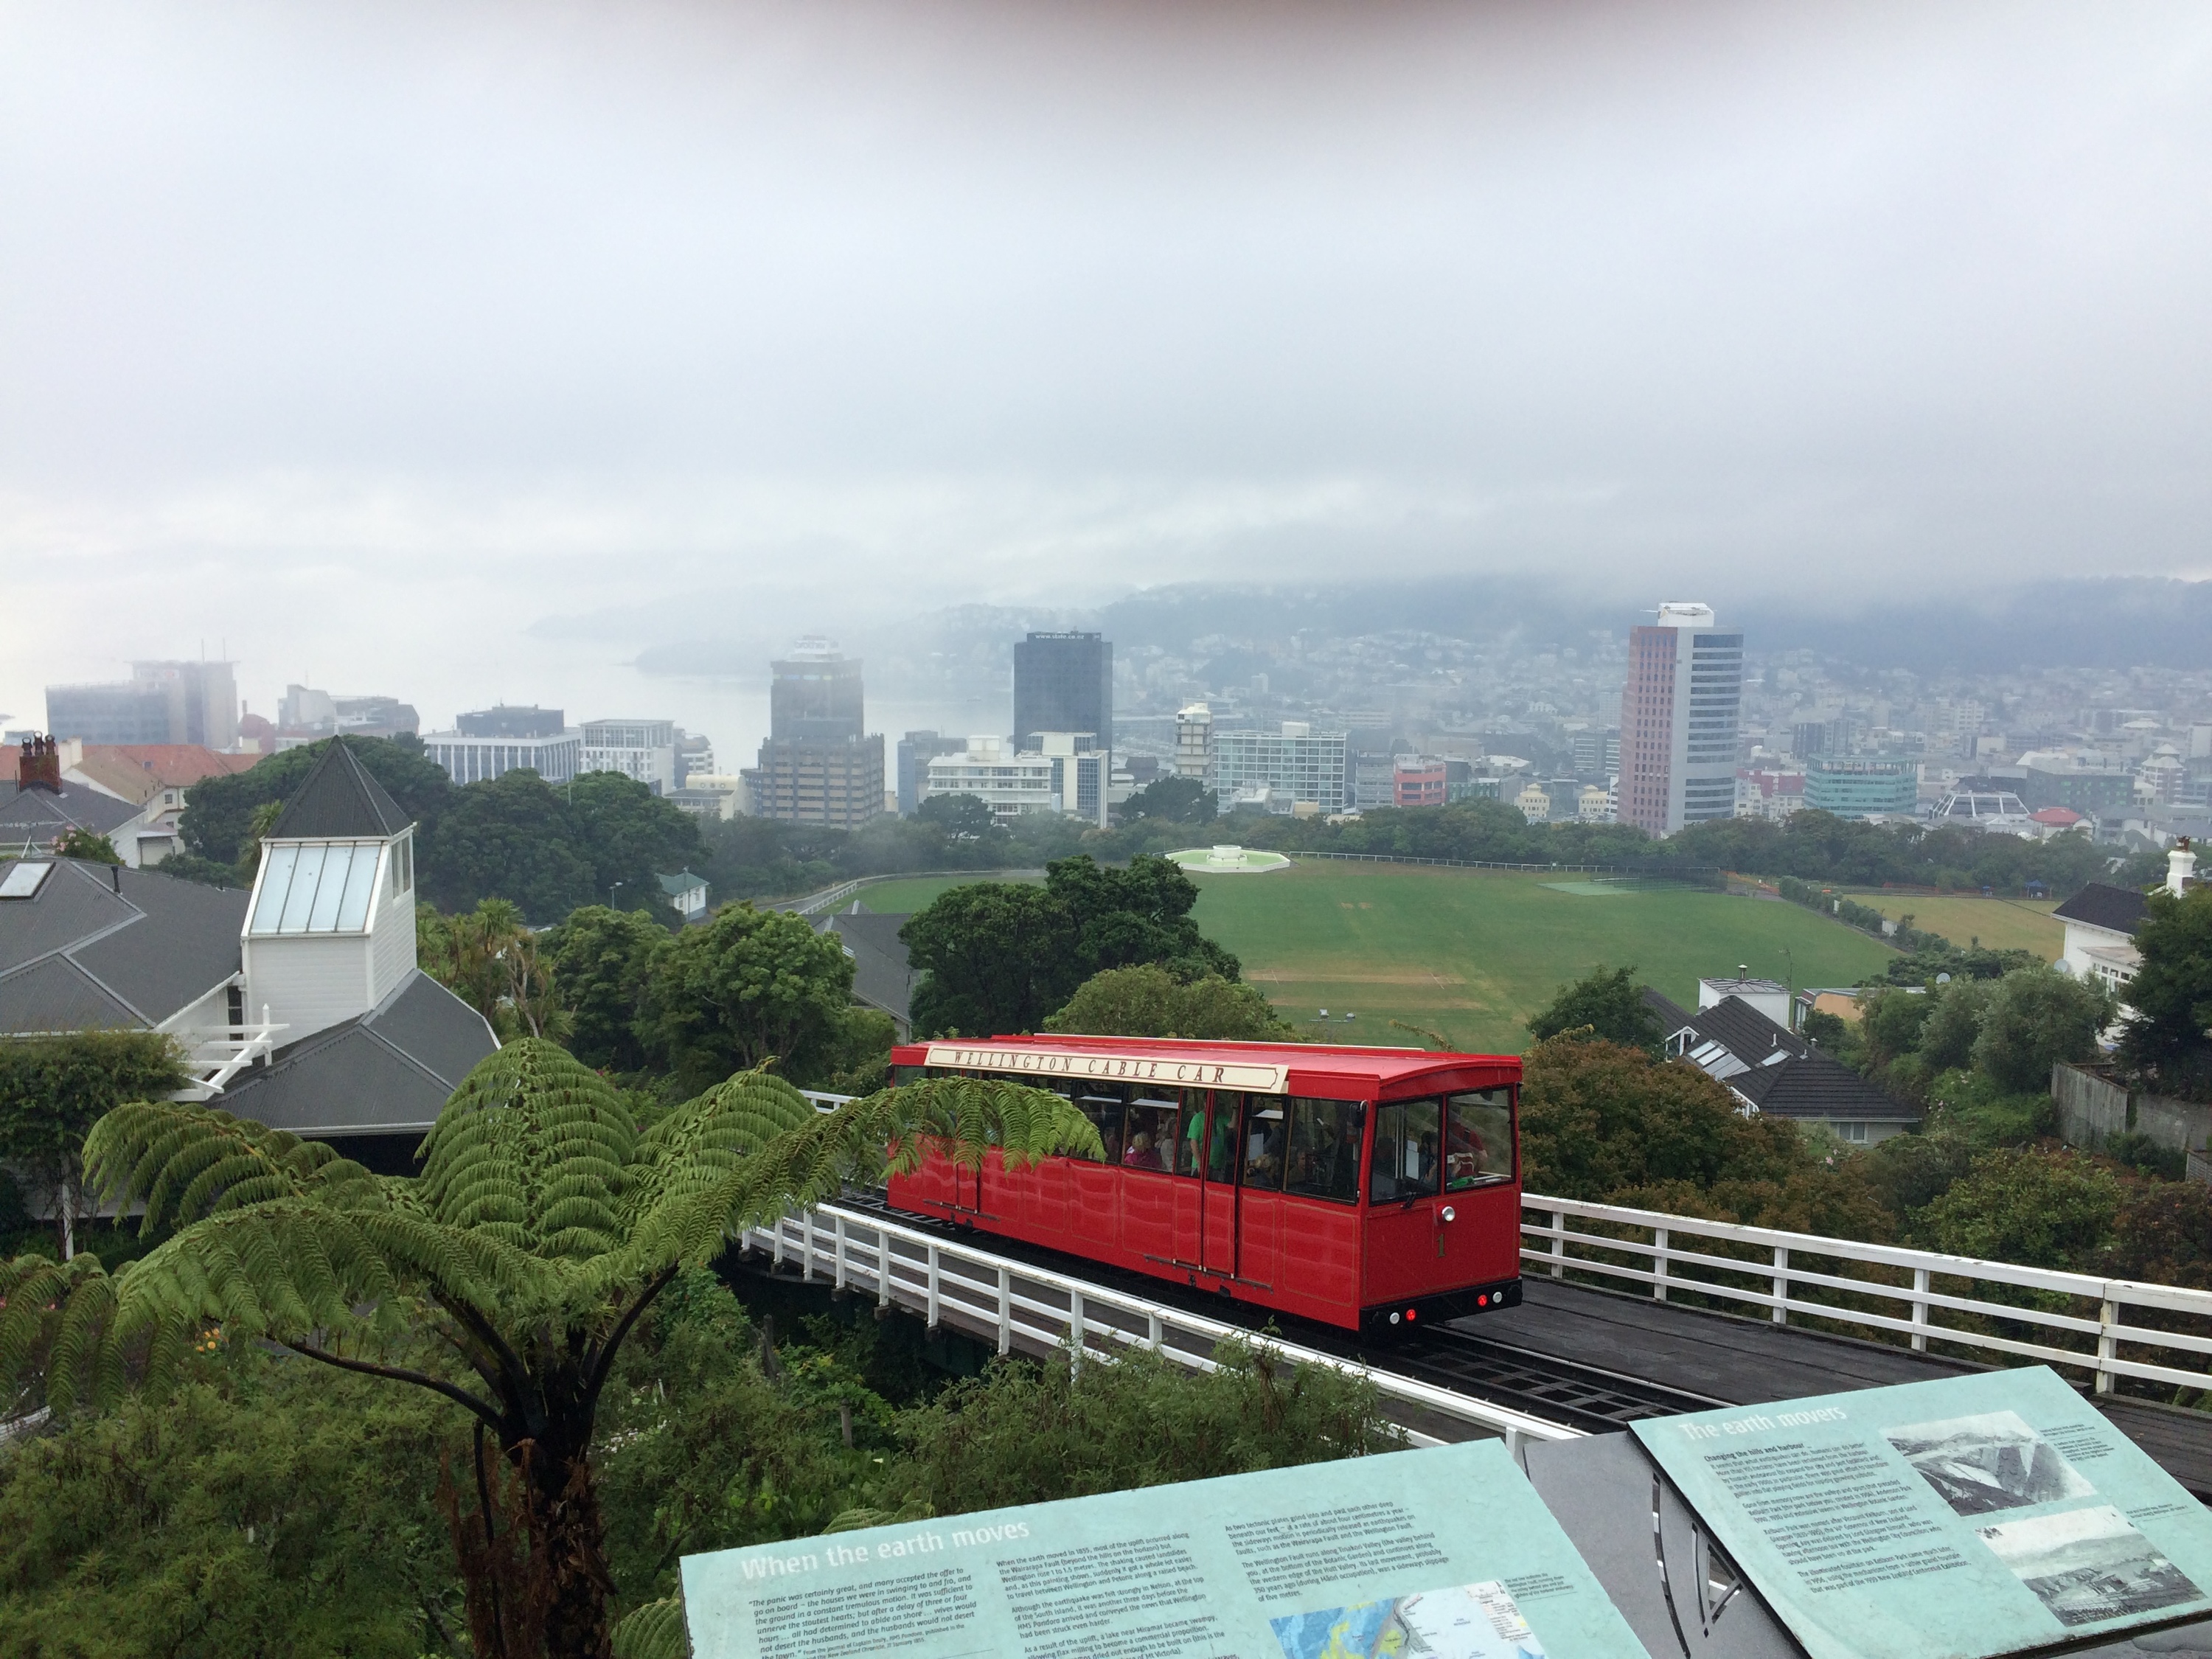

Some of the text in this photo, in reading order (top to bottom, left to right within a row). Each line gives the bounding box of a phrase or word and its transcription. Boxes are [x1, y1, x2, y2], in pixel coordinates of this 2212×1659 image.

[954, 1051, 1225, 1084] WELLINGTON CABLE CAR
[1436, 1234, 1446, 1258] 1
[1678, 1407, 1848, 1440] The earth movers
[741, 1522, 1030, 1580] When the earth moves
[1010, 1564, 1043, 1573] Wairarapa
[1060, 1556, 1086, 1565] (beyond
[1133, 1544, 1159, 1553] horizon)
[1046, 1551, 1067, 1559] moved
[1127, 1538, 1144, 1547] uplift
[1145, 1534, 1171, 1543] occurred
[1323, 1555, 1346, 1564] Botanic
[1347, 1550, 1371, 1559] Garden)
[1385, 1545, 1414, 1554] continues
[1414, 1547, 1441, 1559] probably
[1001, 1573, 1035, 1582] Wellington
[1110, 1557, 1134, 1565] shaking
[1135, 1553, 1155, 1562] caused
[1156, 1549, 1186, 1557] landslides
[1265, 1585, 1283, 1593] years
[1295, 1578, 1321, 1587] (during
[1396, 1558, 1424, 1569] sideways
[1424, 1554, 1449, 1565] slippage
[766, 1596, 786, 1605] panic
[804, 1588, 834, 1598] certainly
[836, 1585, 856, 1595] great,
[858, 1581, 872, 1589] and
[896, 1573, 925, 1583] accepted
[939, 1568, 954, 1577] offer
[776, 1602, 798, 1612] board
[821, 1596, 844, 1604] houses
[886, 1585, 917, 1594] swinging
[928, 1579, 942, 1587] and
[944, 1578, 956, 1586] fro,
[957, 1574, 971, 1582] and
[757, 1624, 786, 1634] unnerve
[801, 1616, 829, 1627] stoutest
[858, 1610, 869, 1618] but
[871, 1607, 887, 1615] after
[896, 1603, 914, 1611] delay
[916, 1600, 923, 1608] of
[953, 1594, 967, 1603] four
[769, 1613, 795, 1624] ground
[813, 1605, 844, 1615] constant
[845, 1600, 880, 1610] tremulous
[882, 1596, 908, 1604] motion.
[933, 1585, 964, 1596] sufficient
[760, 1645, 772, 1653] not
[774, 1641, 796, 1650] desert
[812, 1632, 848, 1644] husbands,
[851, 1629, 865, 1637] and
[880, 1621, 914, 1632] husbands
[917, 1616, 939, 1626] would
[941, 1614, 953, 1622] not
[954, 1611, 974, 1620] desert
